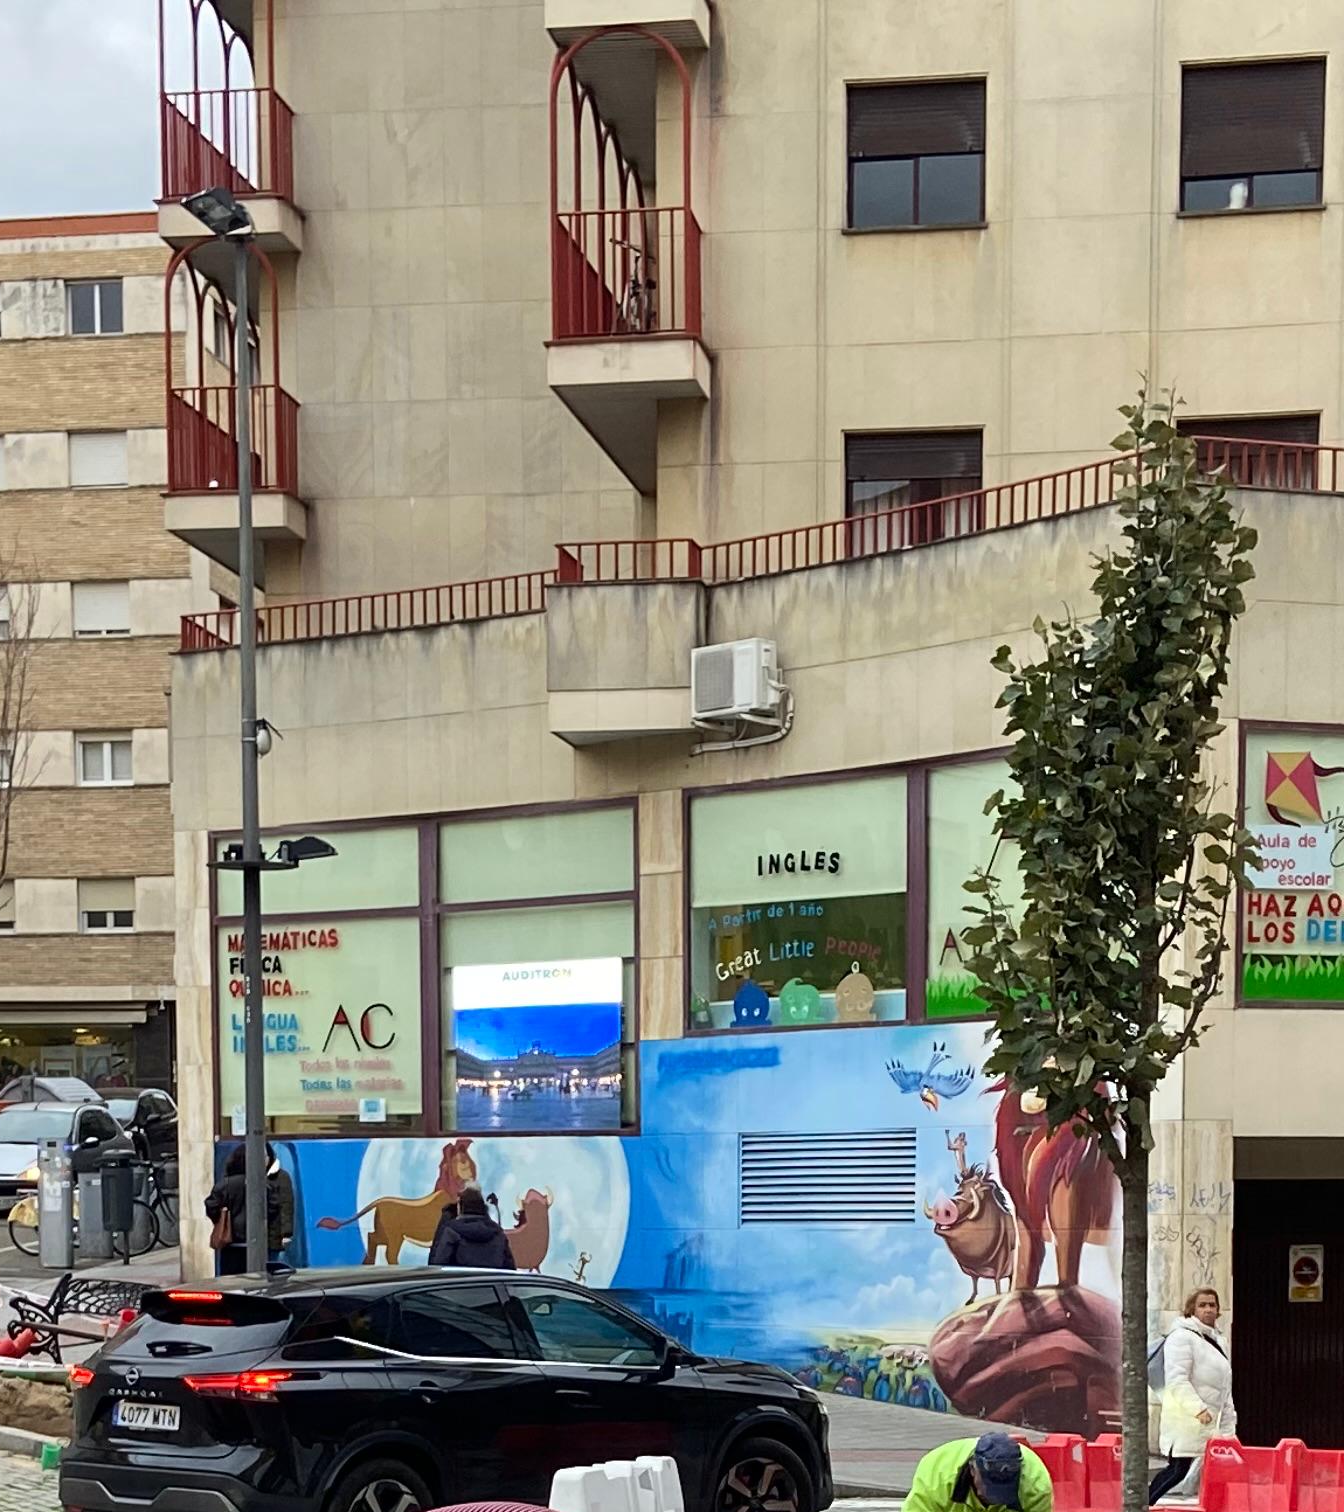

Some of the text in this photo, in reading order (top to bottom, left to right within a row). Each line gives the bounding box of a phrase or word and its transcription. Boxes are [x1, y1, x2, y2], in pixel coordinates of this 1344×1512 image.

[1298, 833, 1317, 848] de
[1260, 856, 1296, 873] poyo
[1277, 871, 1332, 887] escolar
[768, 903, 784, 919] de
[799, 902, 824, 917] año
[1247, 893, 1297, 917] HAZ
[1247, 921, 1296, 944] LOS
[715, 946, 762, 982] Great
[769, 939, 815, 962] Little
[322, 1003, 396, 1052] AC
[336, 1077, 353, 1090] las
[120, 1406, 150, 1424] 4077
